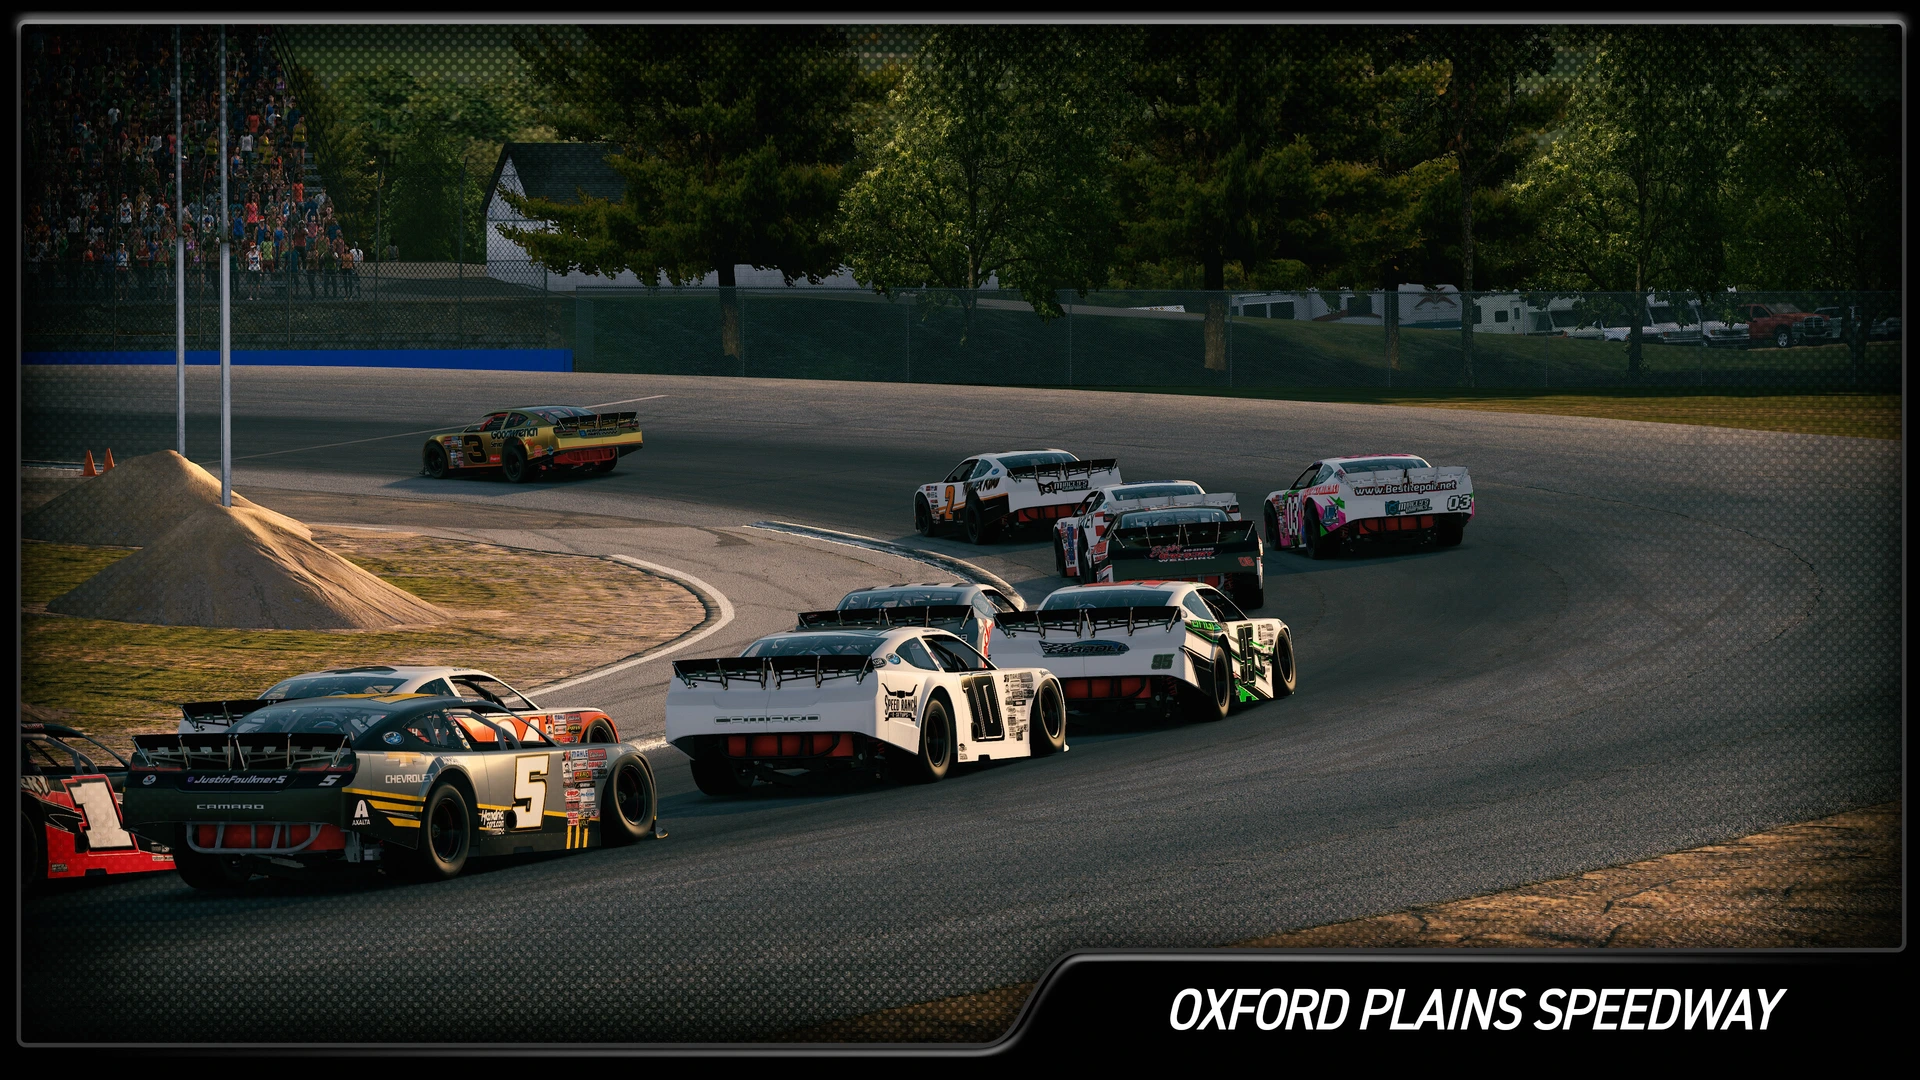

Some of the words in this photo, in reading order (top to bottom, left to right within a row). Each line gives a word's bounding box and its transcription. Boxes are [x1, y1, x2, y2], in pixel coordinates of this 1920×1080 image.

[464, 435, 487, 464] 3
[945, 485, 956, 522] 2
[1447, 495, 1471, 511] 03
[1287, 494, 1299, 536] 03
[885, 695, 900, 715] SPEED
[901, 696, 917, 715] RANCH
[960, 674, 1004, 742] 10
[714, 714, 821, 725] CAMARO
[194, 774, 287, 785] JustinFaulkner5
[318, 774, 342, 787] 5
[385, 773, 434, 784] CHEVROLET
[512, 753, 550, 832] 5
[68, 780, 134, 849] 1
[352, 819, 371, 827] AXALTA
